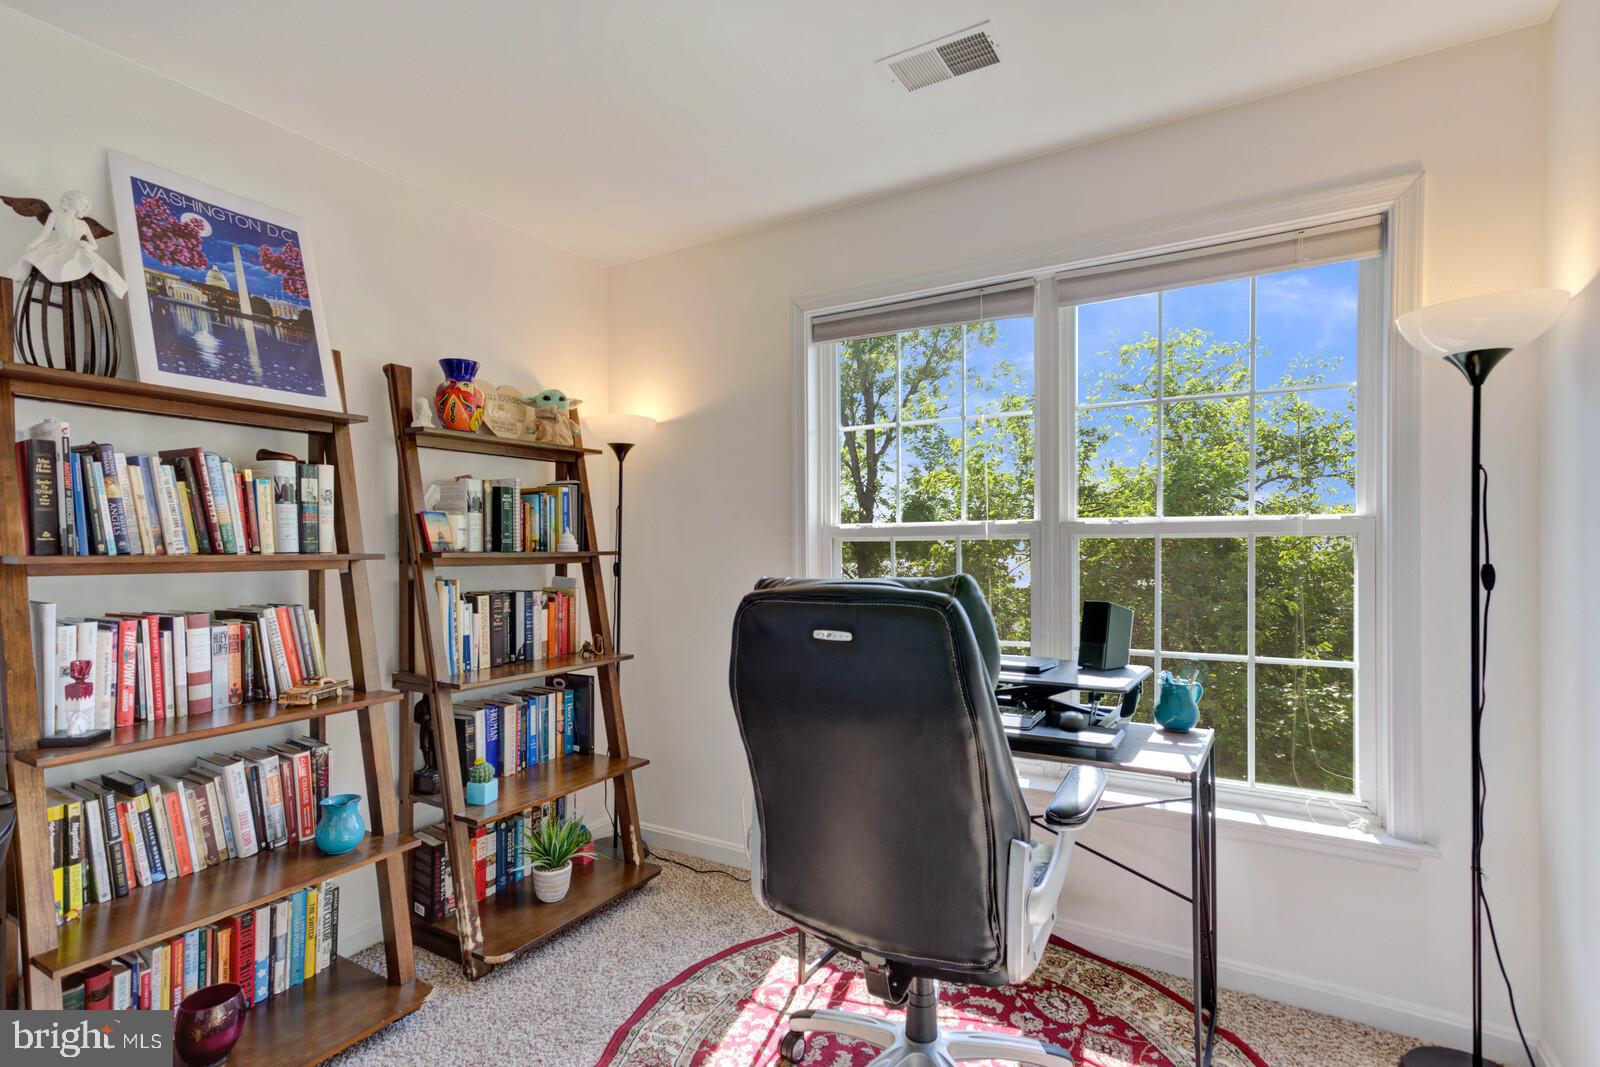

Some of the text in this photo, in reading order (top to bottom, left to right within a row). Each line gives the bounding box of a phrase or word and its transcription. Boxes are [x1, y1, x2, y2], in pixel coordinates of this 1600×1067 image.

[136, 180, 297, 243] WASHINGTON D.C.
[109, 502, 119, 535] ANGELS
[122, 630, 136, 686] THIS TOWN
[488, 706, 499, 741] TRUMAN
[70, 822, 80, 860] Negotiating
[145, 812, 156, 845] AMERICA'S
[307, 902, 316, 940] THE SWITCH
[322, 912, 333, 942] CULTURE
